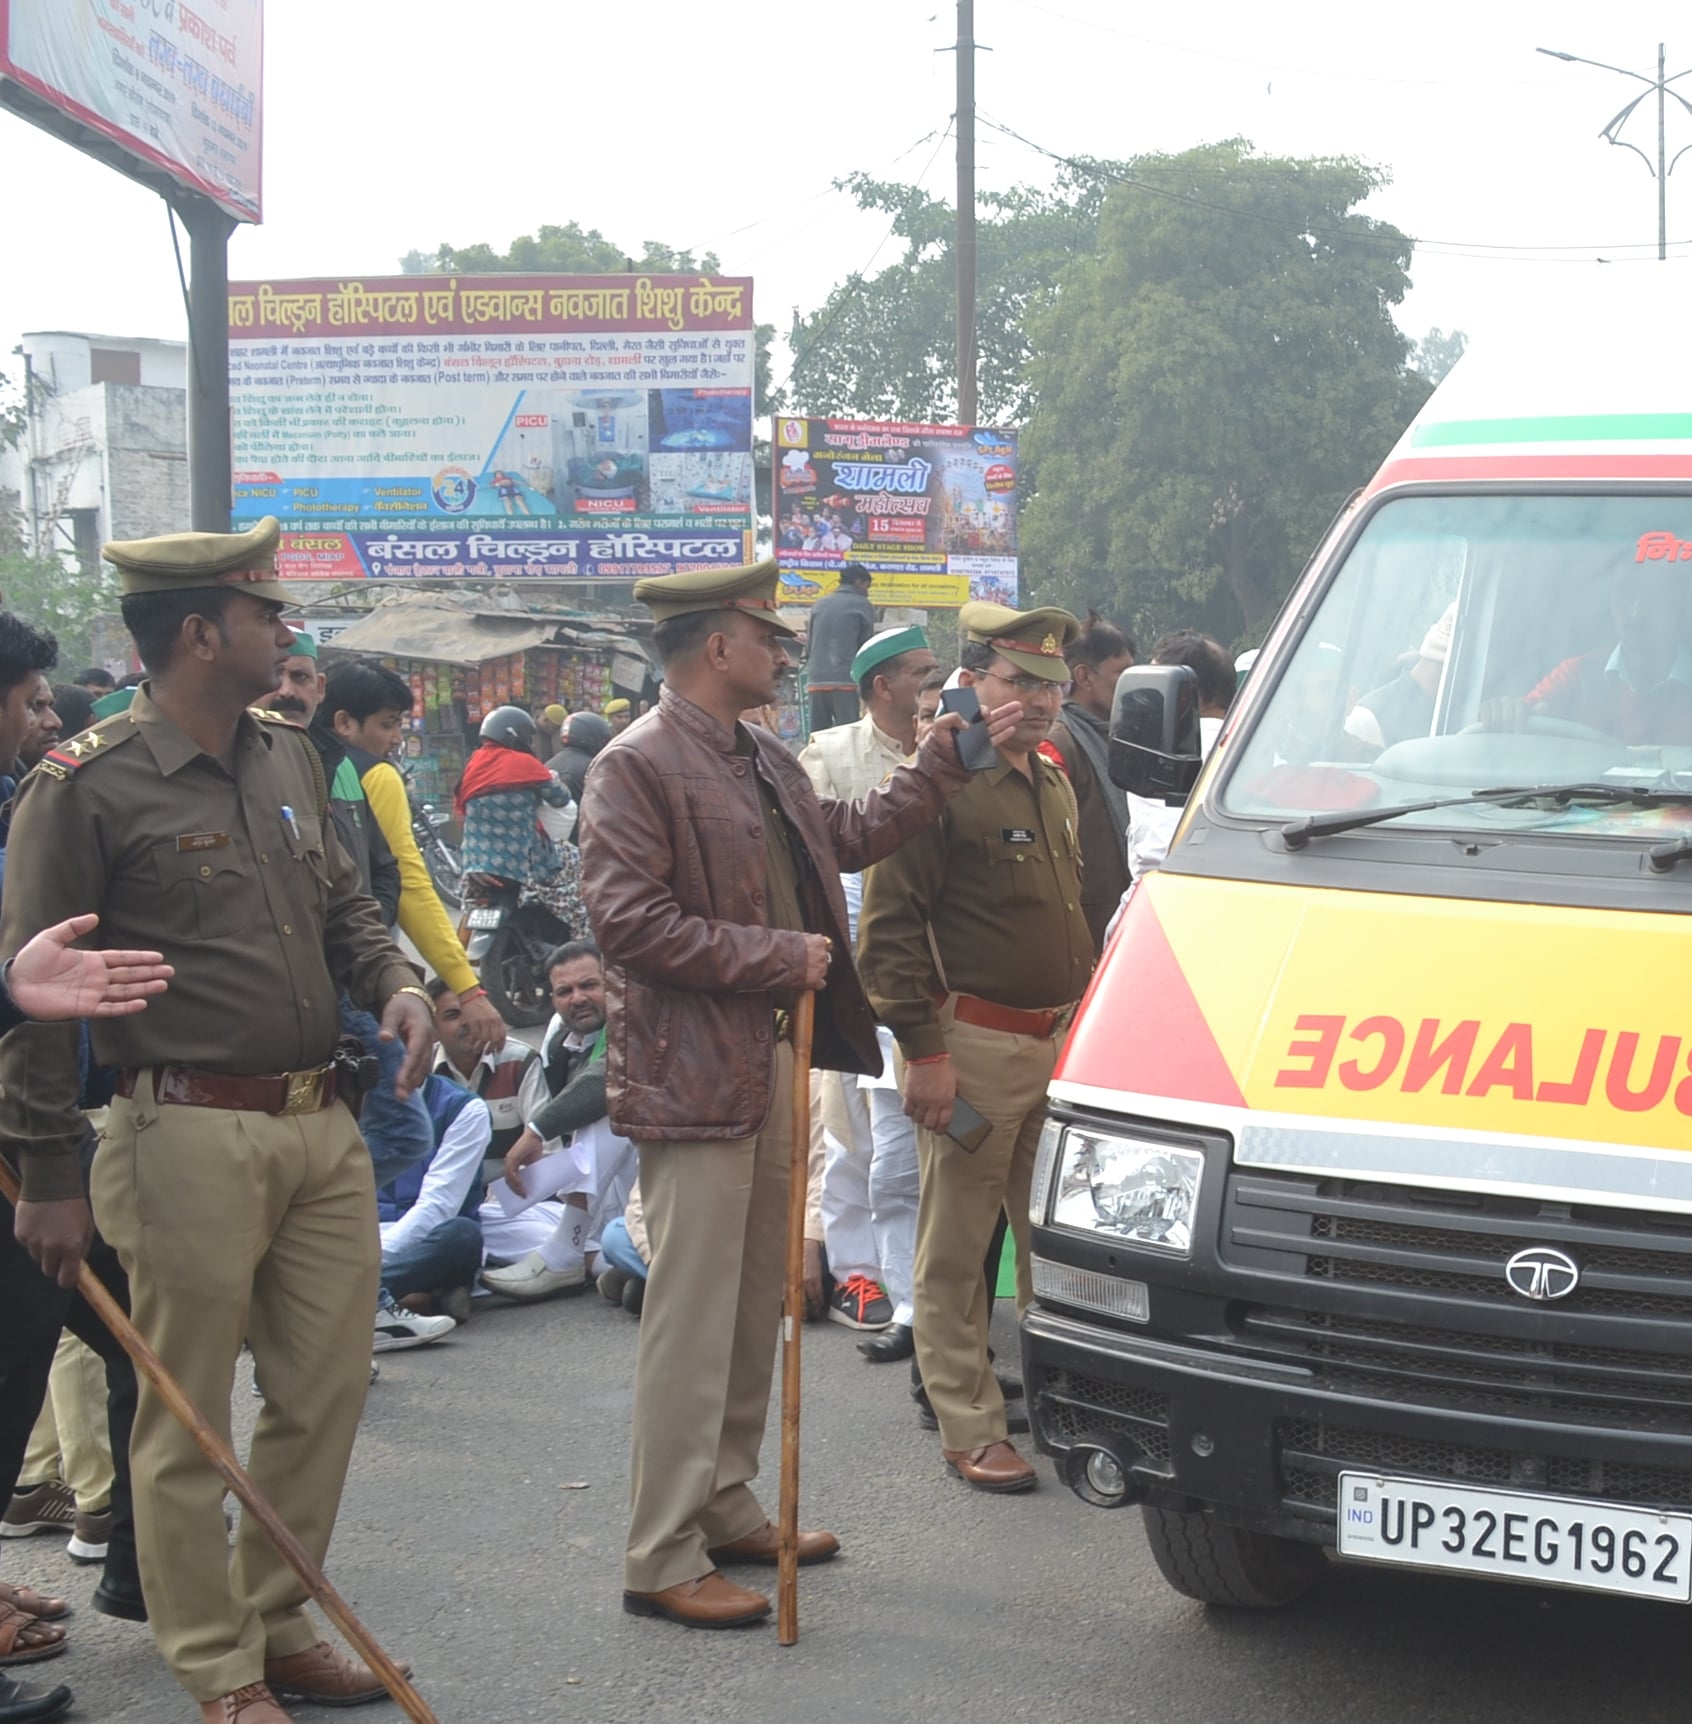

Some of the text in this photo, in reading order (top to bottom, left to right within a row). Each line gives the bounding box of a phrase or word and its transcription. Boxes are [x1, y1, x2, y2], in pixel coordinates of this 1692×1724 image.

[228, 277, 744, 333] ल चिल्ड्रन हॉस्पिटल एवं एडवान्स नवजात शिशु केन्द्र
[244, 360, 278, 370] Neonatal
[281, 360, 307, 370] Centre
[434, 371, 461, 386] (Post
[464, 371, 490, 386] term)
[517, 416, 547, 427] PICU
[832, 457, 931, 492] शामली
[251, 488, 277, 497] NICU
[293, 488, 318, 497] PICU
[375, 487, 422, 497] Ventilator
[293, 503, 360, 513] Phototherapy
[588, 500, 624, 508] NICU
[854, 490, 932, 515] महोत्सव
[873, 519, 889, 532] 15
[290, 534, 343, 550] बंसल
[366, 533, 740, 563] बंसल चिल्ड्रन हॉस्पिटल
[1348, 1509, 1373, 1524] IND
[1380, 1498, 1678, 1584] UP32EG1962
